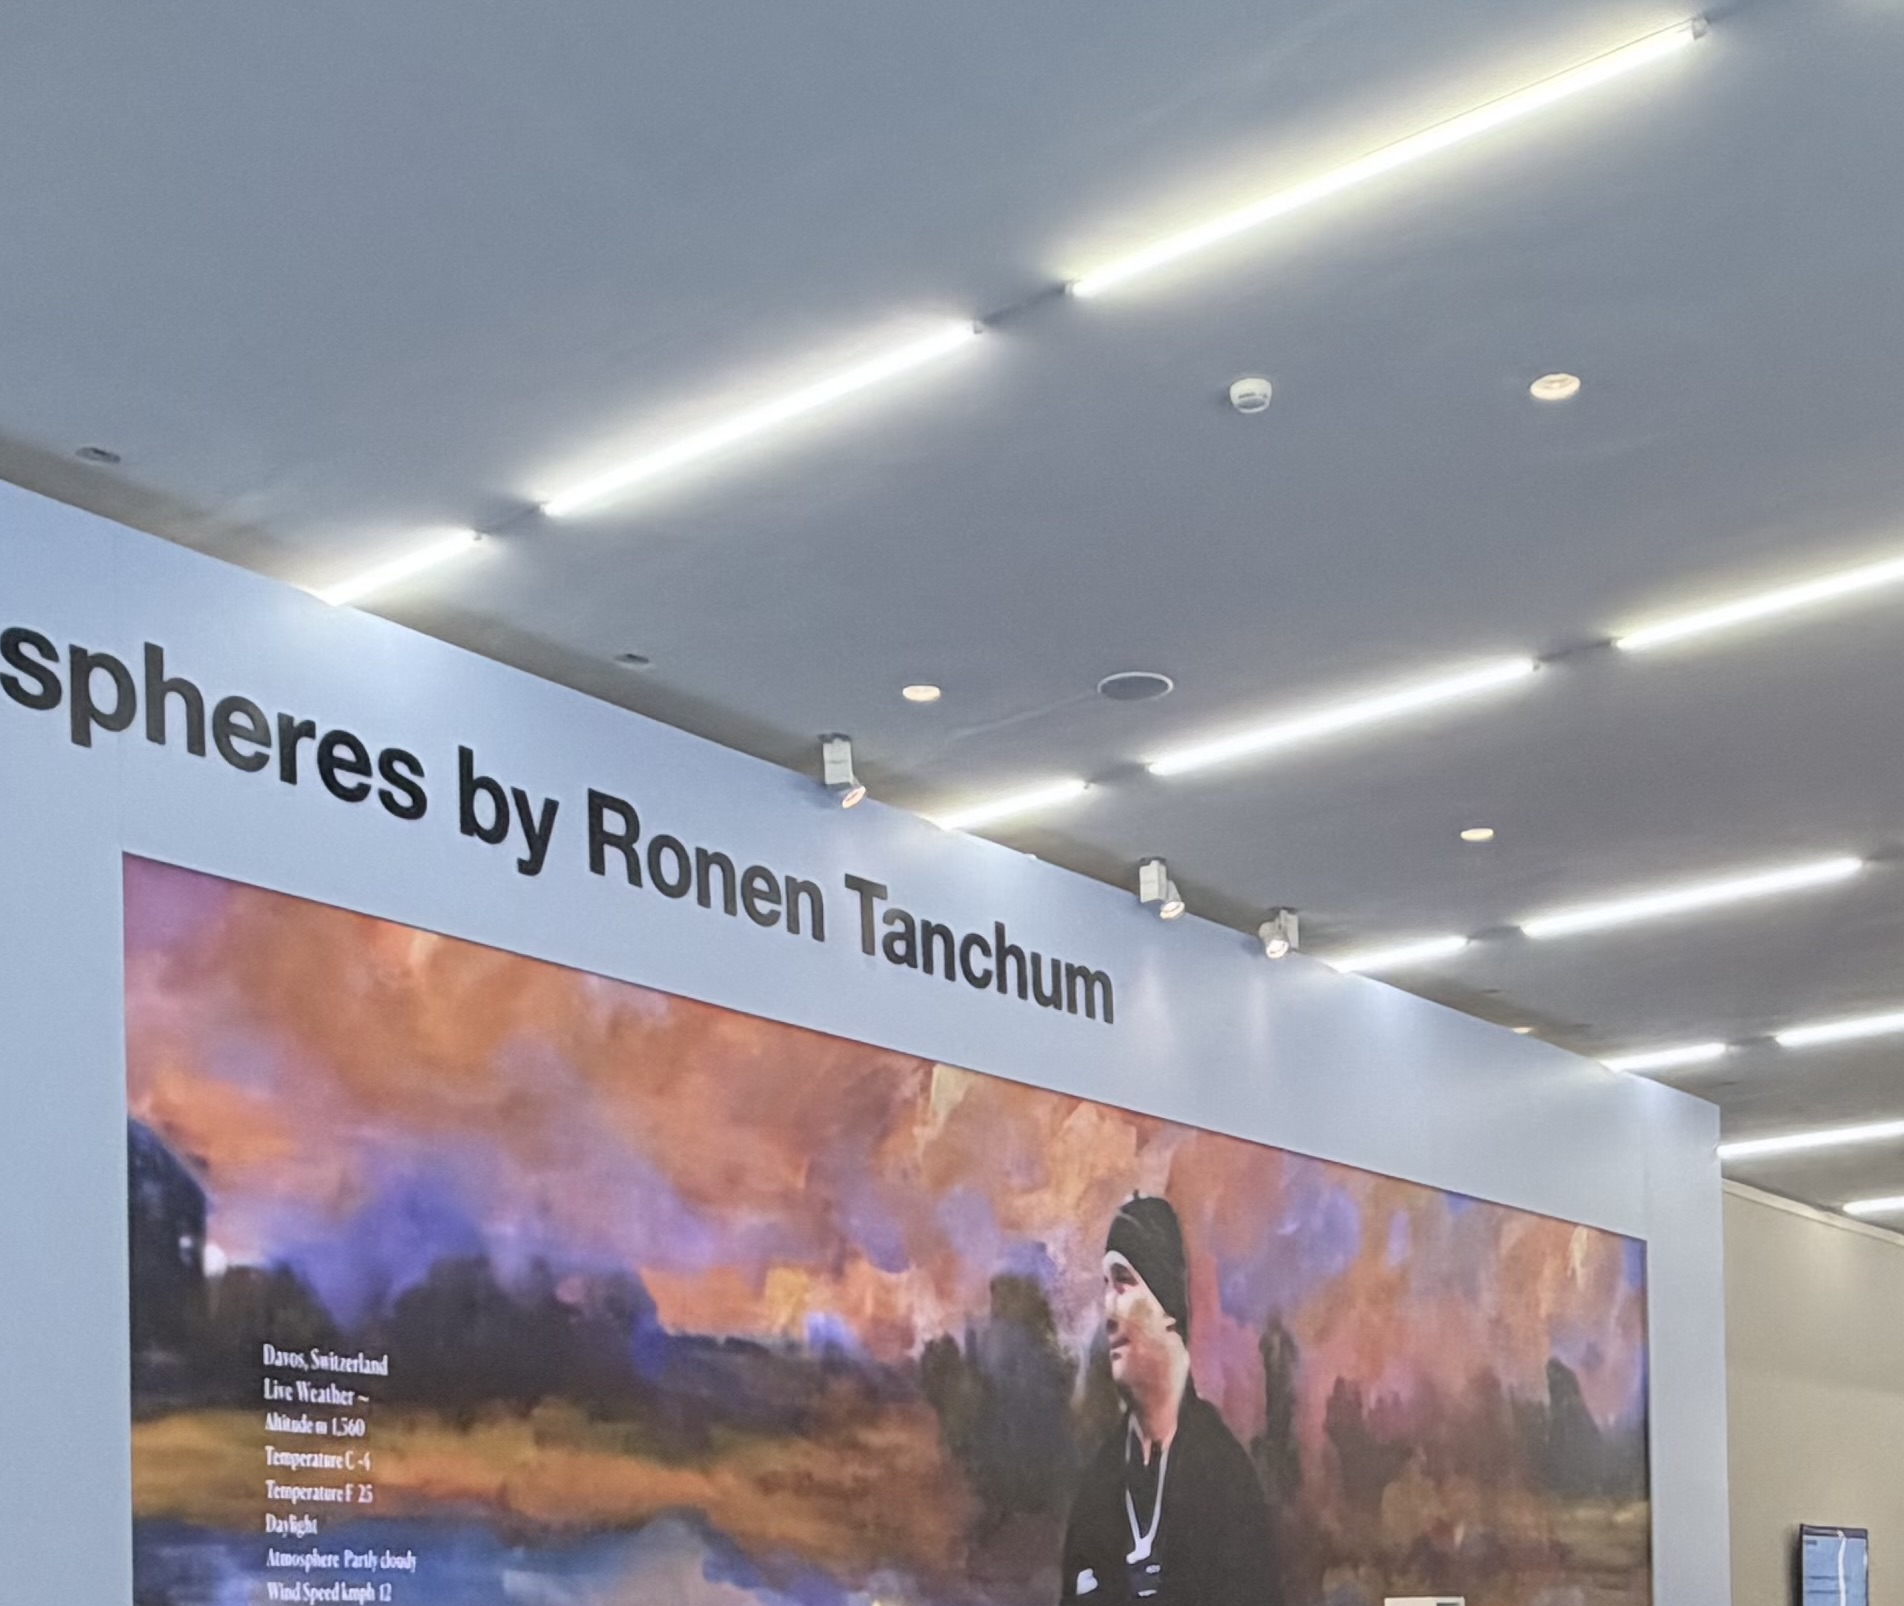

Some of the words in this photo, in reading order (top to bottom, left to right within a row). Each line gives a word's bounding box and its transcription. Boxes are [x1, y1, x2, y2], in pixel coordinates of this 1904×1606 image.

[459, 746, 559, 876] by
[588, 788, 824, 942] Ronen
[845, 876, 1115, 1024] Tanchum
[263, 1343, 308, 1371] Davos,
[311, 1348, 388, 1376] Switzerland
[264, 1377, 293, 1400] Live
[296, 1380, 355, 1405] Weather
[265, 1412, 314, 1434] Altitude
[315, 1421, 327, 1434] m
[265, 1445, 343, 1471] Temperature
[345, 1451, 354, 1470] C
[265, 1480, 344, 1504] Temperature
[345, 1484, 353, 1501] F
[358, 1484, 373, 1503] 25
[266, 1513, 318, 1538] Daylight
[266, 1548, 340, 1572] Atmosphere
[344, 1549, 378, 1572] Partly
[380, 1549, 416, 1573] cloudy
[267, 1581, 301, 1601] Wind
[303, 1581, 340, 1605] Speed
[341, 1581, 375, 1605] kmph
